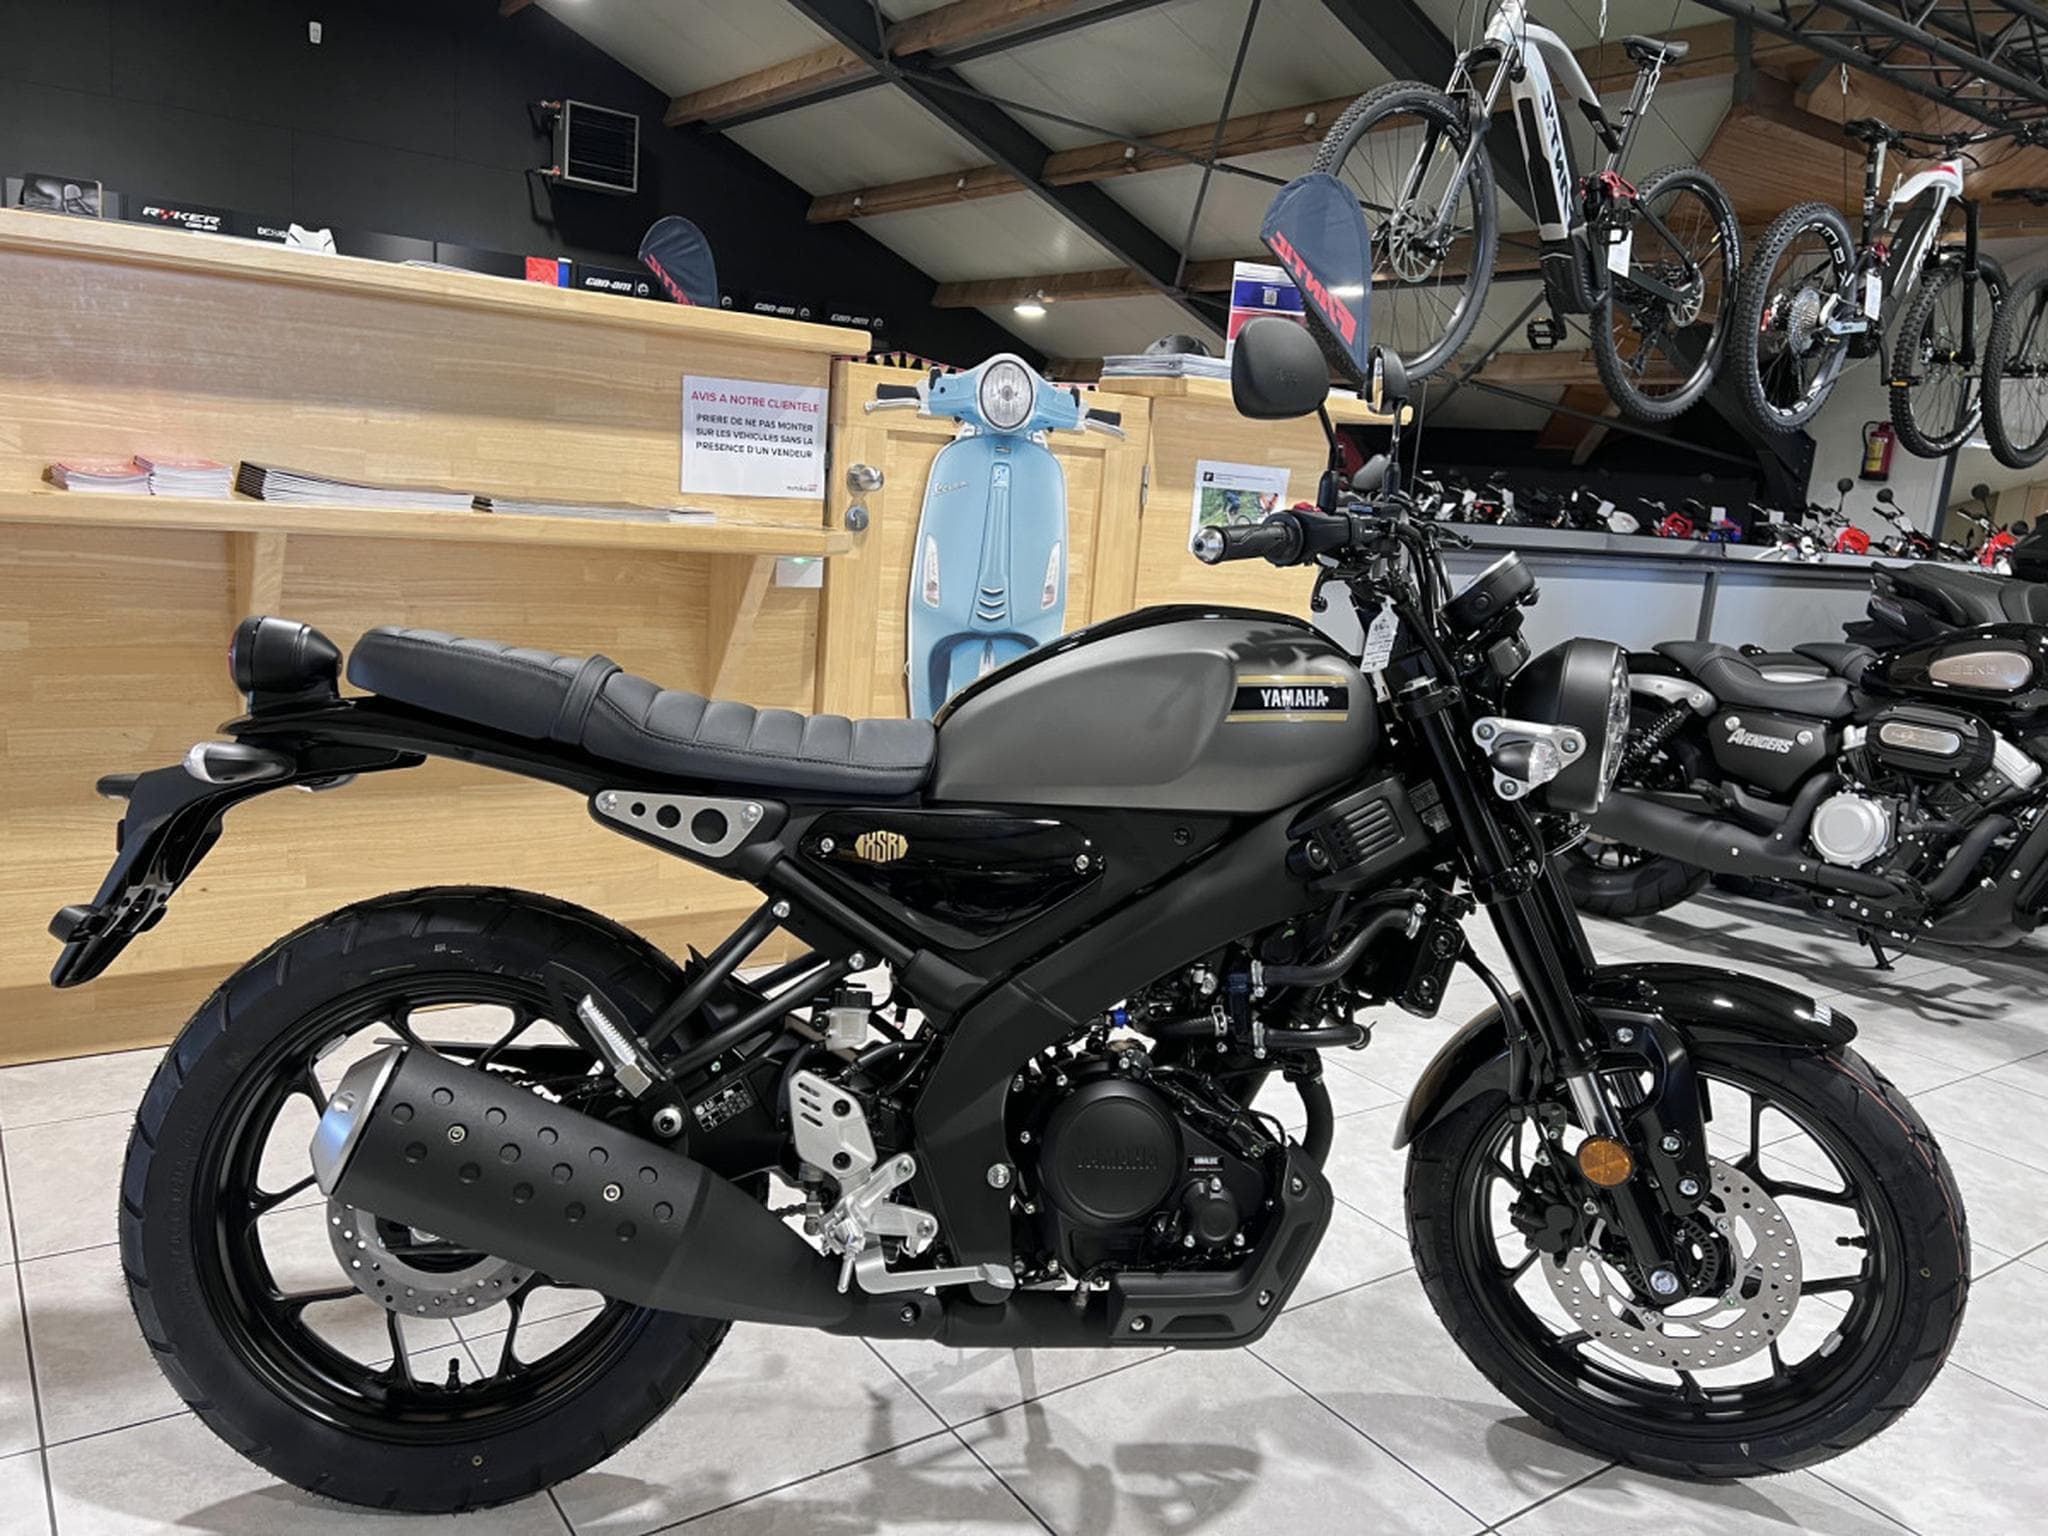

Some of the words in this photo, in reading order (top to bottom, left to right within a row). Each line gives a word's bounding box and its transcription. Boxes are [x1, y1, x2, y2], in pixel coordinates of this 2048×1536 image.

[142, 206, 220, 225] RYKER
[691, 391, 717, 403] AVIS
[719, 394, 728, 404] A
[730, 395, 765, 408] NOTRE
[767, 399, 820, 413] CLIENTELE
[696, 414, 729, 425] PRIERE
[730, 416, 742, 426] DE
[745, 417, 756, 427] NE
[759, 419, 776, 430] PAS
[777, 421, 814, 432] MONTER
[696, 427, 714, 437] SUR
[716, 429, 731, 438] LES
[732, 430, 779, 443] VEHICULES
[780, 435, 801, 445] SANS
[803, 437, 814, 446] LA
[696, 441, 744, 453] PRESENCE
[747, 445, 769, 455] D'UN
[771, 447, 813, 458] VENDEUR
[1260, 689, 1328, 707] YAMAHA
[864, 830, 900, 863] XSR
